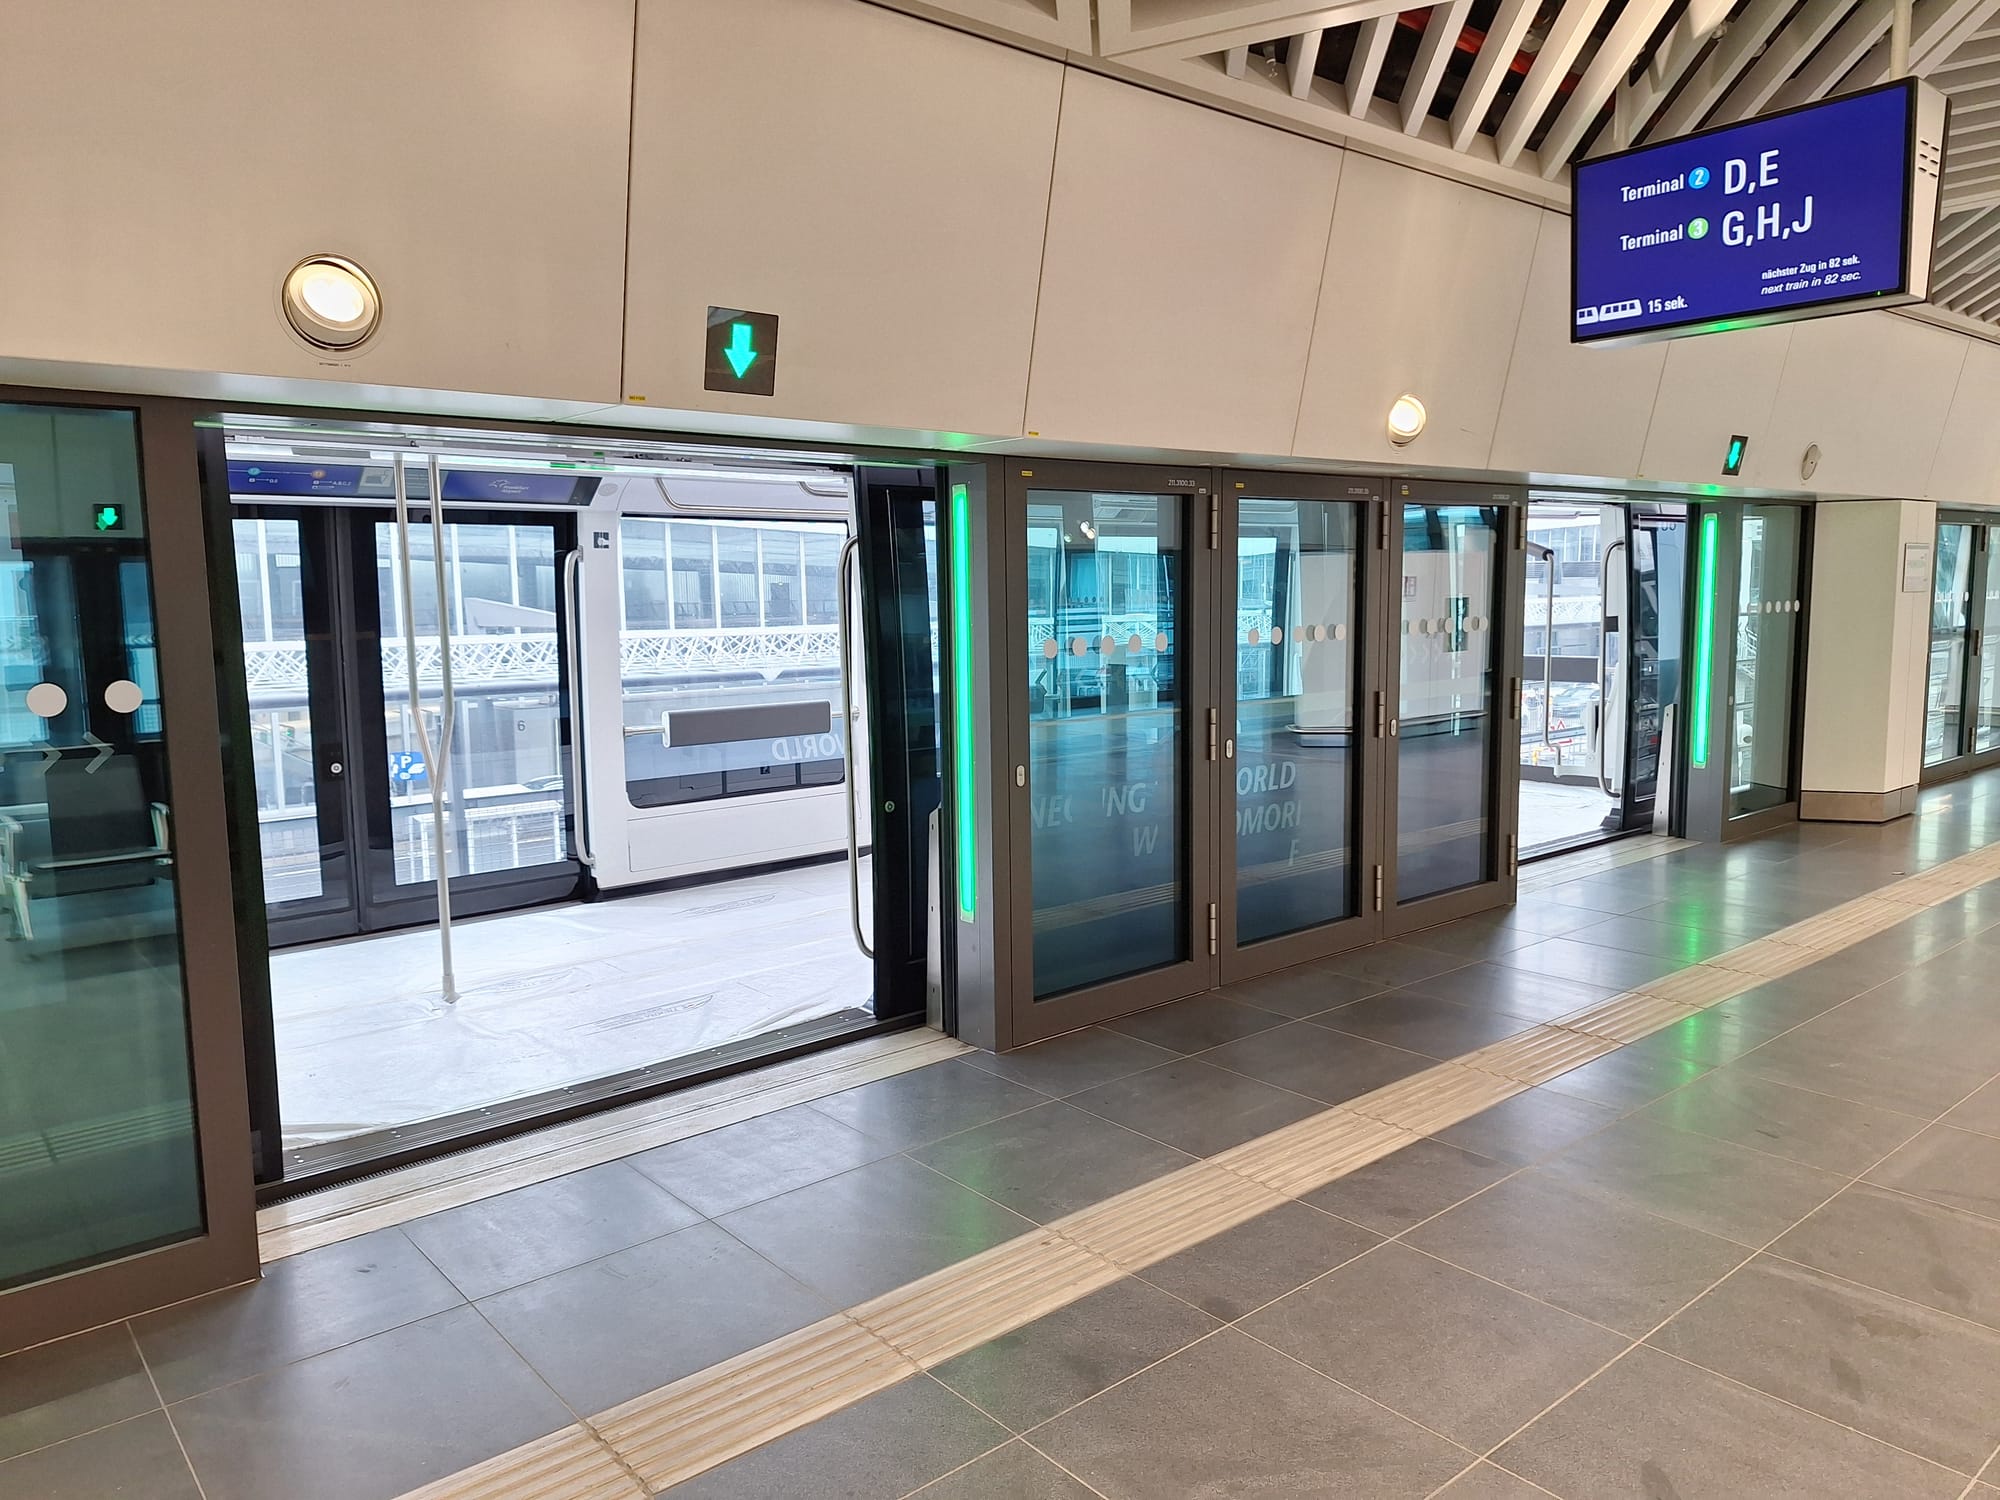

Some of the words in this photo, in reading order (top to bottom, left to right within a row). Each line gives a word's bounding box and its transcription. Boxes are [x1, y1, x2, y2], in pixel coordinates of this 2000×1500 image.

[1621, 173, 1685, 202] Terminal
[1694, 168, 1705, 186] 2
[1724, 149, 1780, 195] D,E
[1620, 223, 1684, 251] Terminal
[1693, 220, 1703, 237] 3
[1722, 195, 1813, 247] G,H,J
[1761, 266, 1798, 280] nächster
[1799, 263, 1817, 274] Zug
[1818, 260, 1827, 270] in
[1761, 283, 1784, 295] next
[1785, 279, 1809, 291] train
[1811, 276, 1821, 287] in
[1647, 298, 1662, 314] 15
[1664, 295, 1689, 311] sek.
[517, 719, 526, 732] 6
